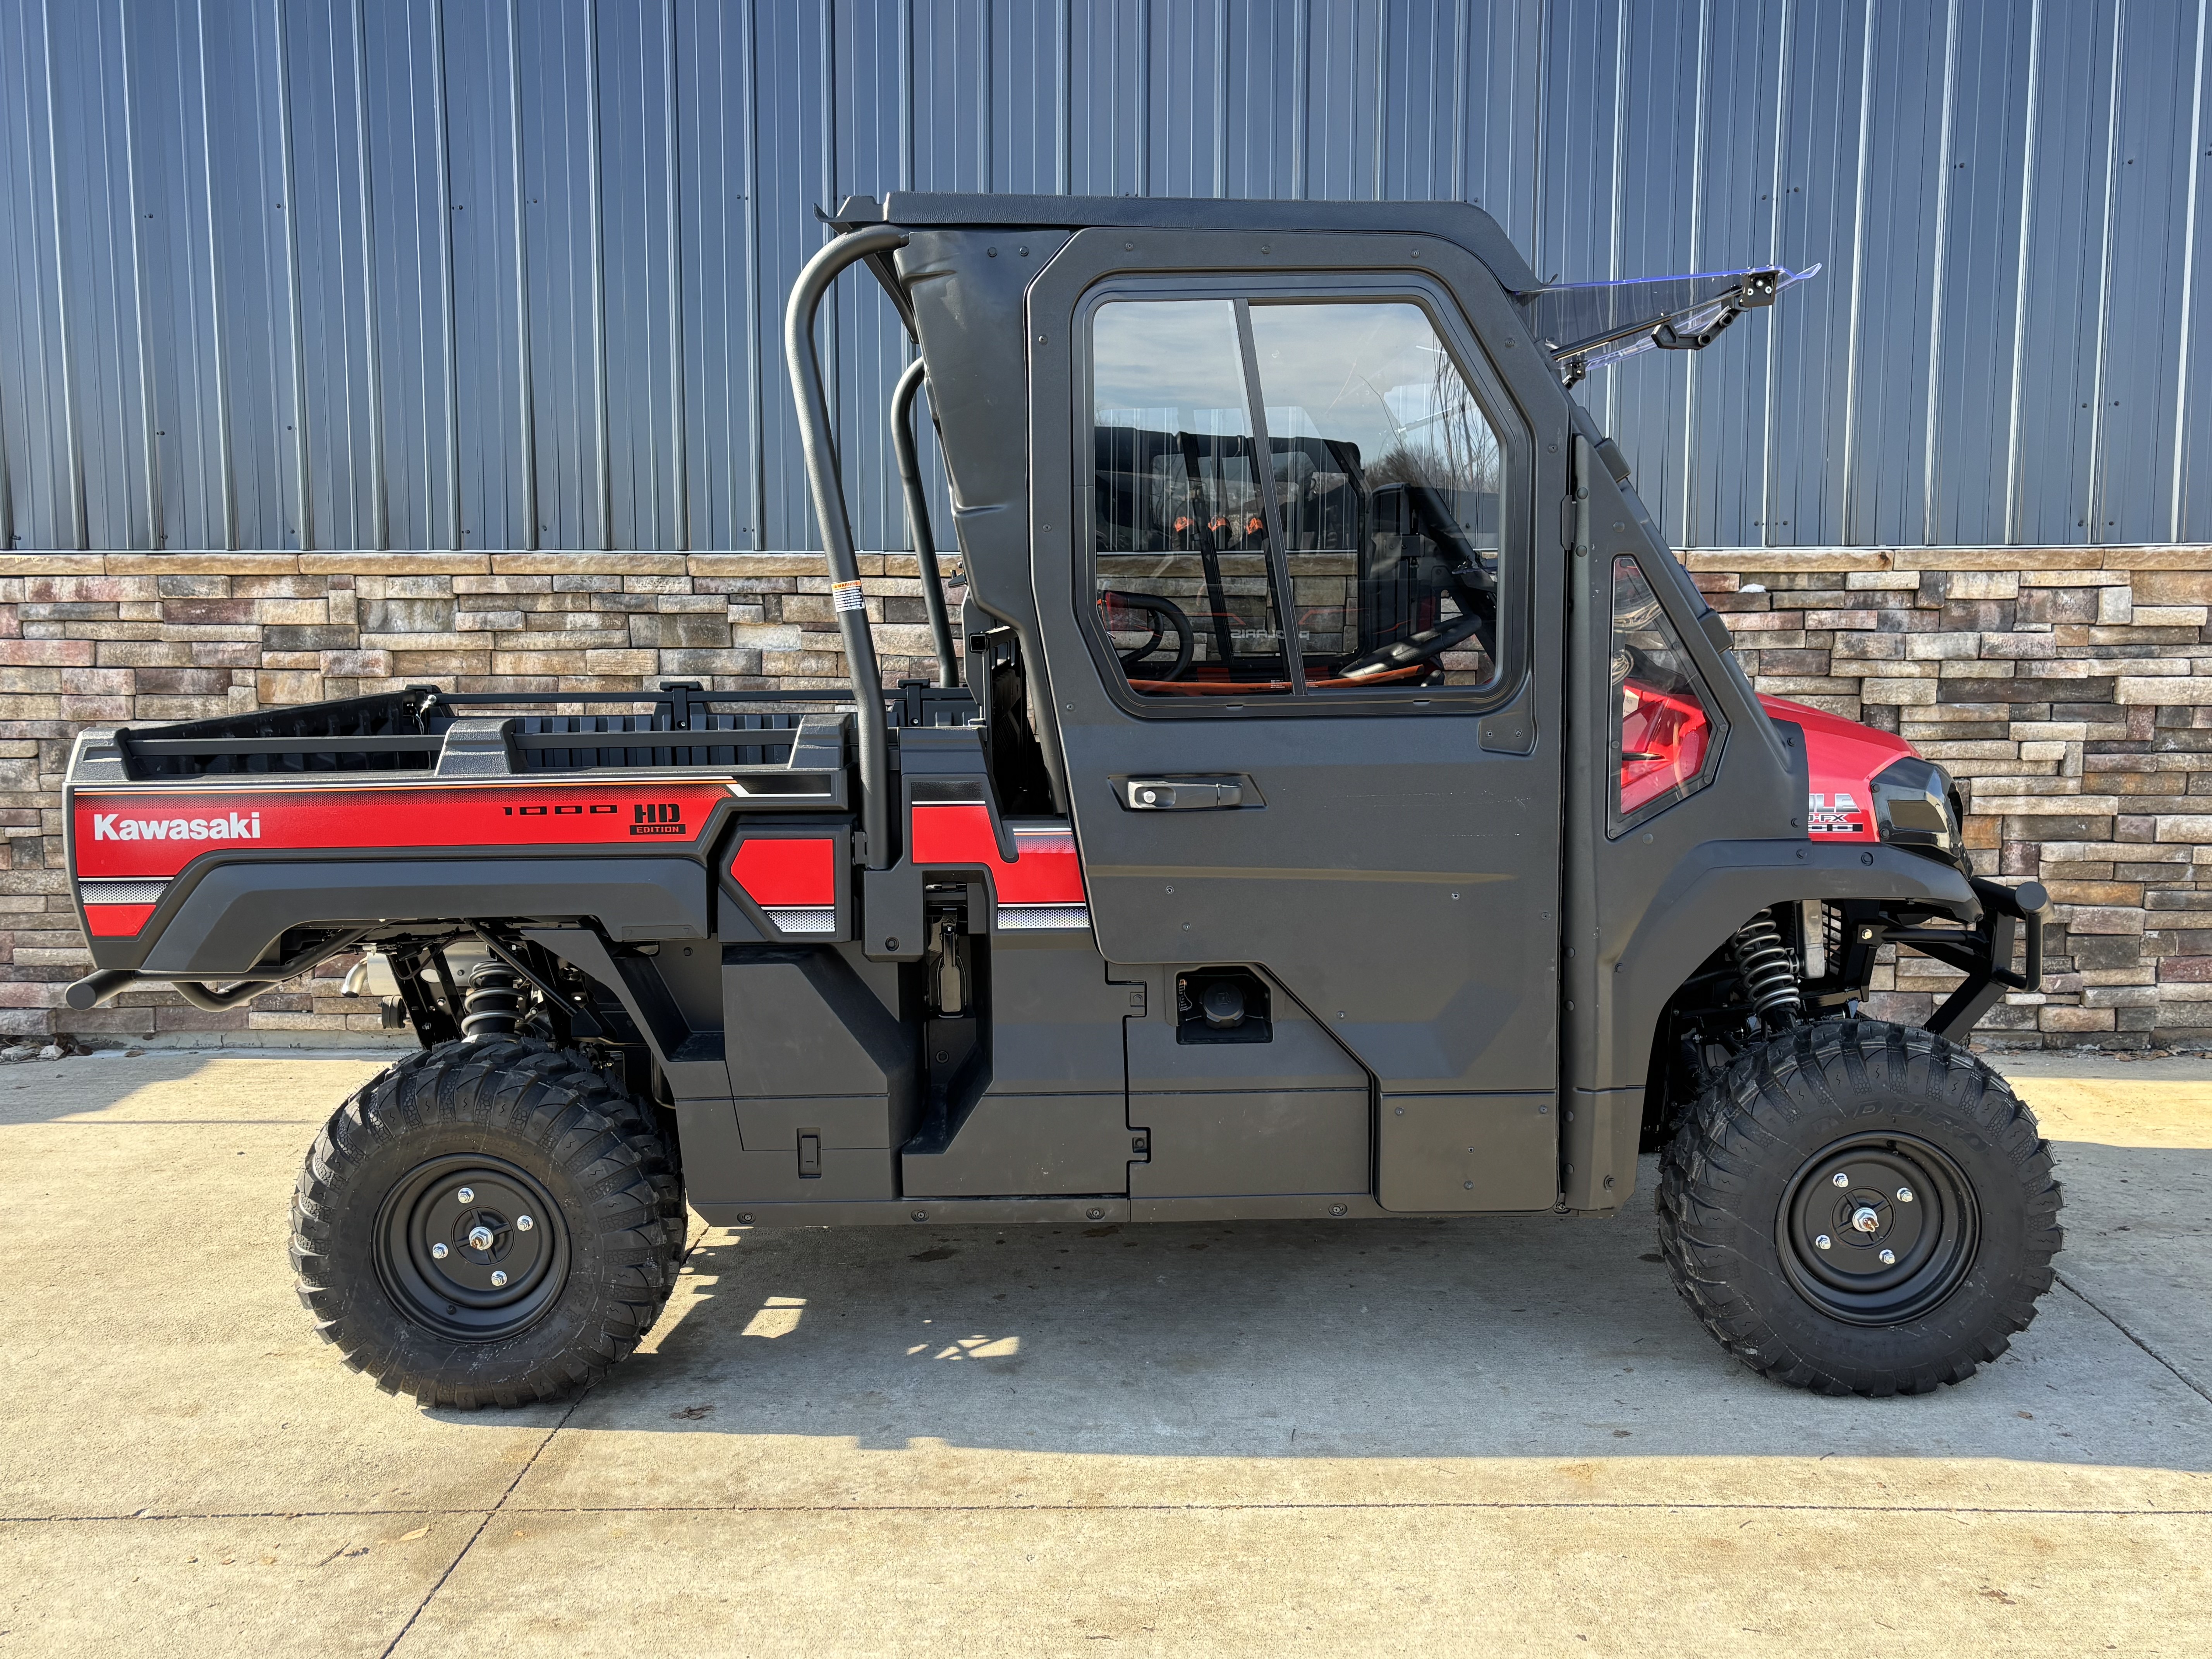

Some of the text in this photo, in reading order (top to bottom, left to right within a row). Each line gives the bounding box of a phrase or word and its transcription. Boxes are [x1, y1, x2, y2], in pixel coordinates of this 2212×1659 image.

[502, 803, 680, 823] 1000 HD
[94, 812, 261, 840] Kawasaki
[636, 826, 679, 834] EDITION
[1853, 1099, 1989, 1153] DURO
